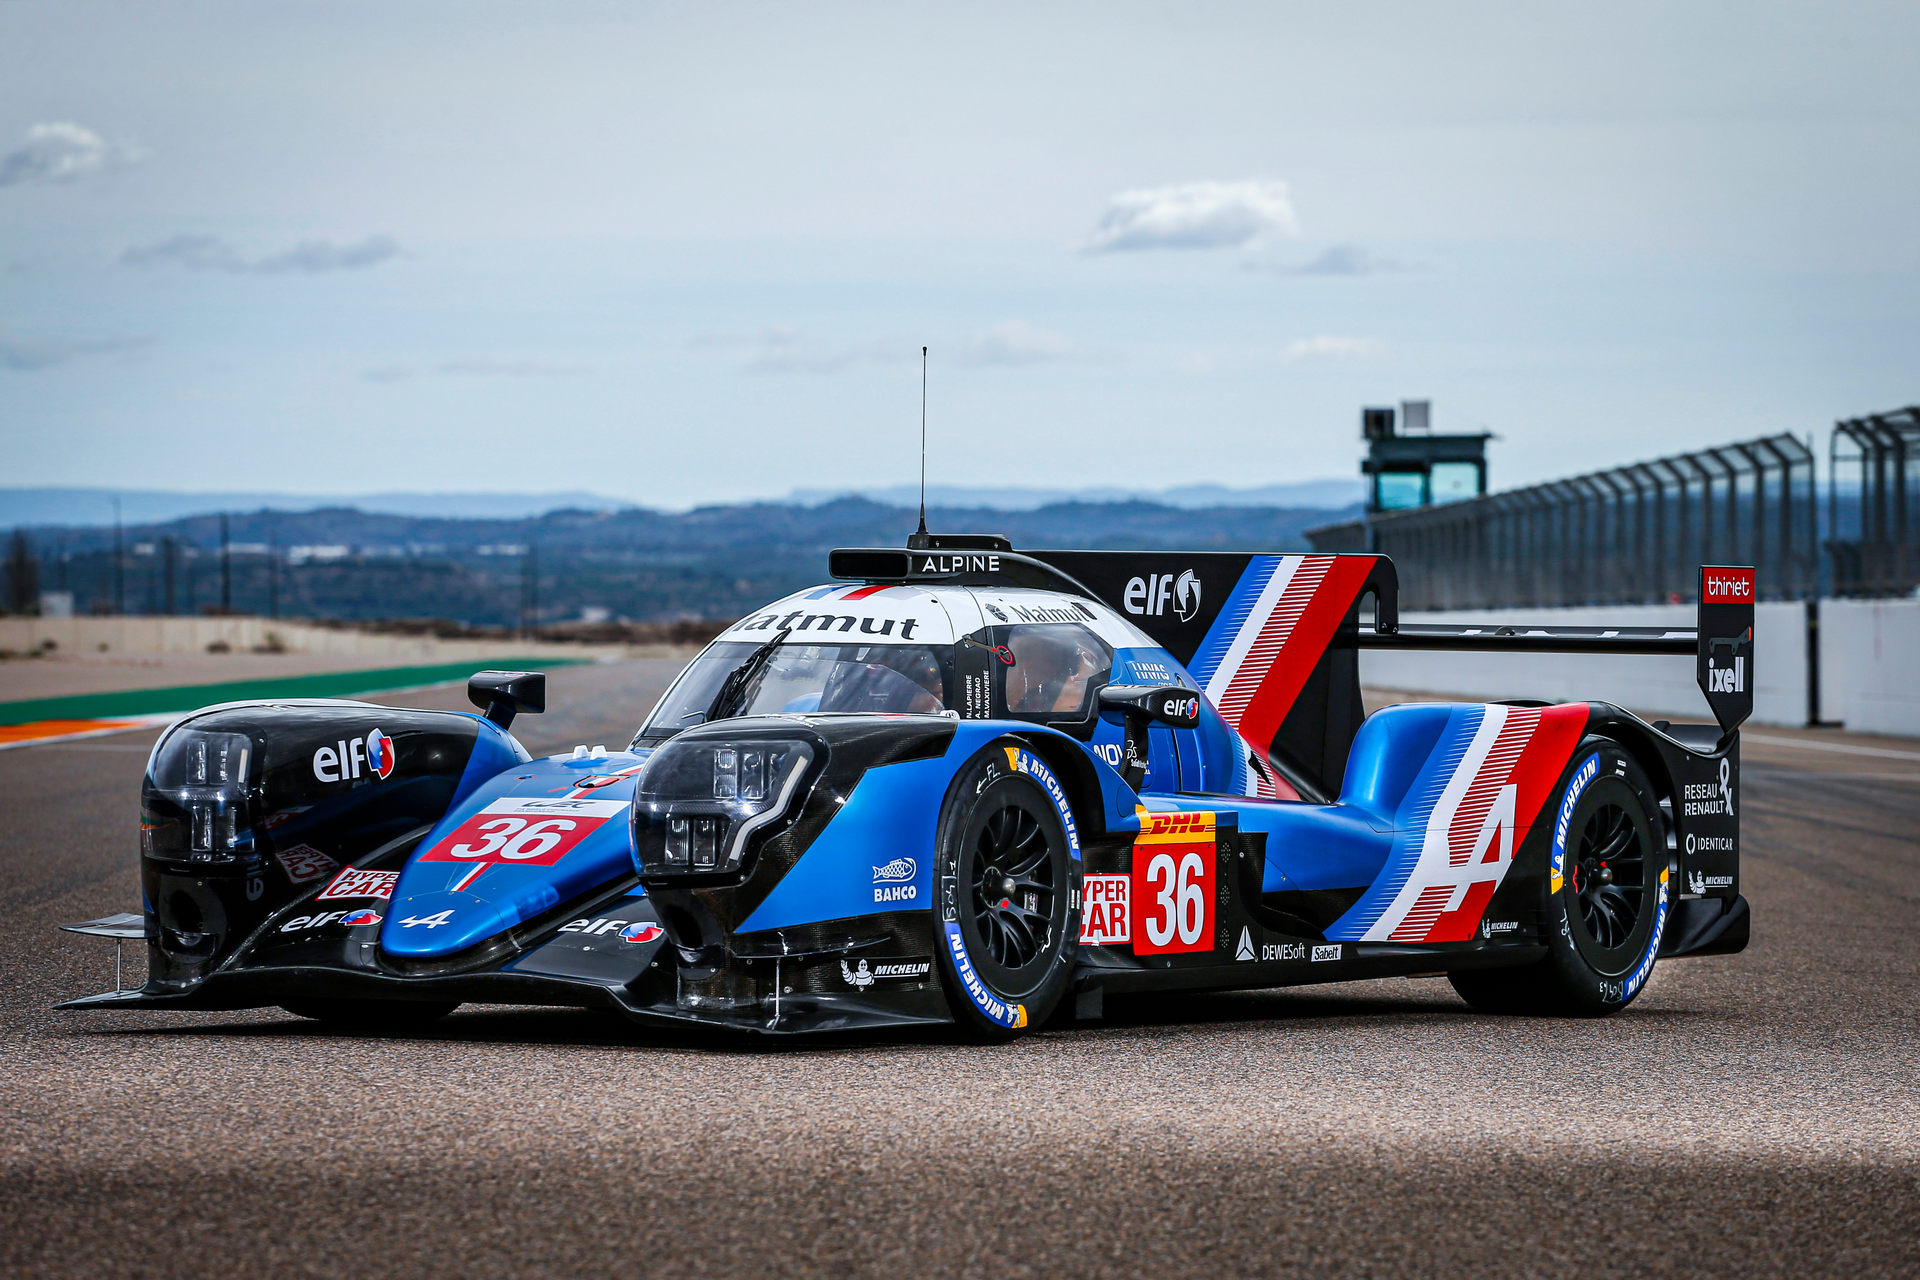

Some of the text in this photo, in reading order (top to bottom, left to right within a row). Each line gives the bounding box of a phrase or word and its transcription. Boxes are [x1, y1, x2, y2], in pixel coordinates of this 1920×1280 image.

[922, 555, 1001, 573] ALPINE
[1123, 574, 1174, 616] elf
[1708, 576, 1750, 597] thiriet
[1709, 657, 1745, 692] ixell
[1163, 699, 1187, 717] elf
[313, 737, 365, 783] elf
[1684, 784, 1719, 800] RESEAU
[1030, 759, 1080, 850] MICHELIN
[1556, 759, 1597, 850] MICHELIN
[1684, 800, 1725, 817] RENAULT
[1150, 812, 1206, 835] DHL
[450, 818, 581, 861] 36
[1697, 837, 1734, 851] IDENTICAR
[341, 871, 400, 881] HYPE
[1704, 876, 1734, 886] MICHELIN
[327, 881, 396, 897] CAR
[873, 885, 917, 903] BAHCO
[1082, 880, 1127, 902] YPER
[1145, 852, 1205, 947] 36
[280, 910, 349, 932] elf
[557, 918, 628, 936] elf
[1490, 921, 1519, 930] MICHELIN
[1262, 943, 1306, 961] DEWESoft
[1313, 946, 1339, 962] Sabelt
[1627, 907, 1667, 997] MICHELIN
[874, 962, 930, 976] MICHELIN
[950, 933, 1006, 1021] MICHELIN
